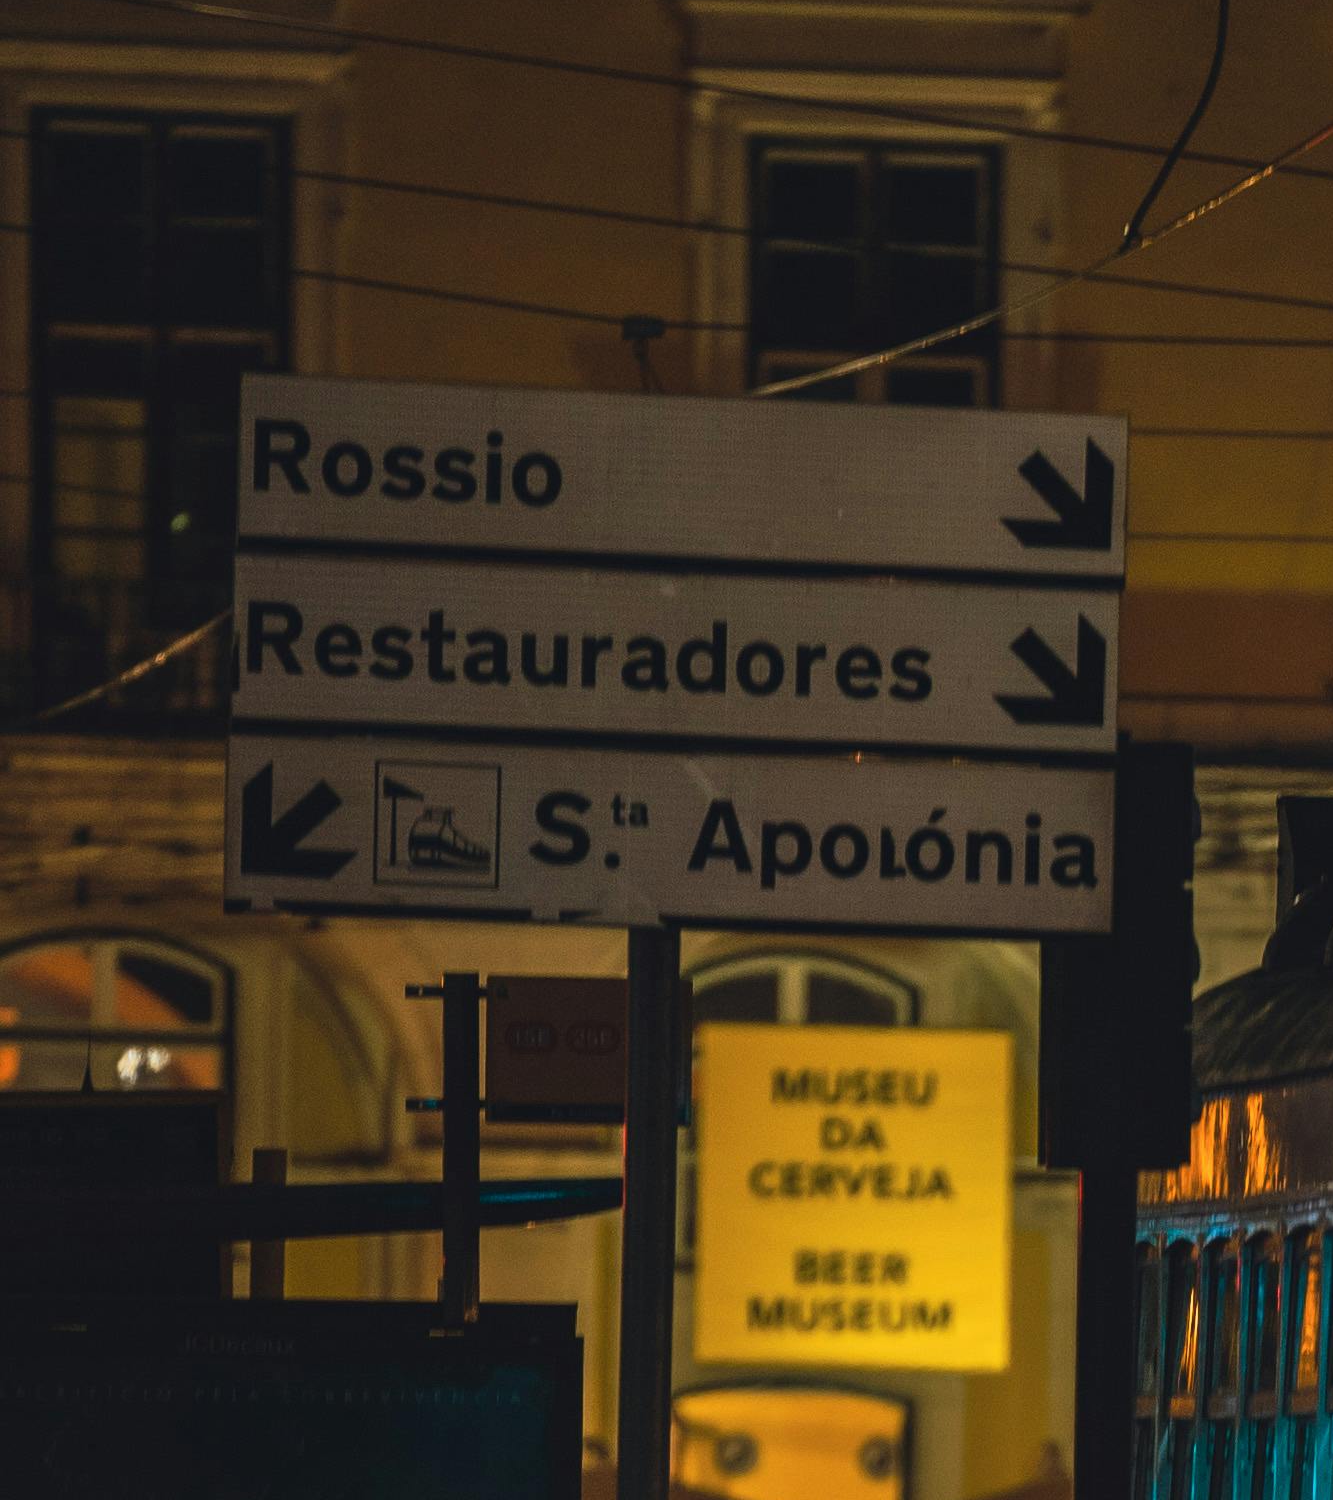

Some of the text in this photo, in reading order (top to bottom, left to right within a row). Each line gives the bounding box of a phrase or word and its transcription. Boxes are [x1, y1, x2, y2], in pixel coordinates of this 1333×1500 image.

[252, 419, 563, 506] Rossio
[247, 601, 932, 701] Restauradores
[687, 799, 1098, 889] Apolónia
[770, 1067, 939, 1106] MUSEU
[819, 1117, 886, 1150] DA
[747, 1161, 953, 1199] CERVEJA
[793, 1250, 909, 1285] BEER
[746, 1295, 953, 1333] MUSEUM
